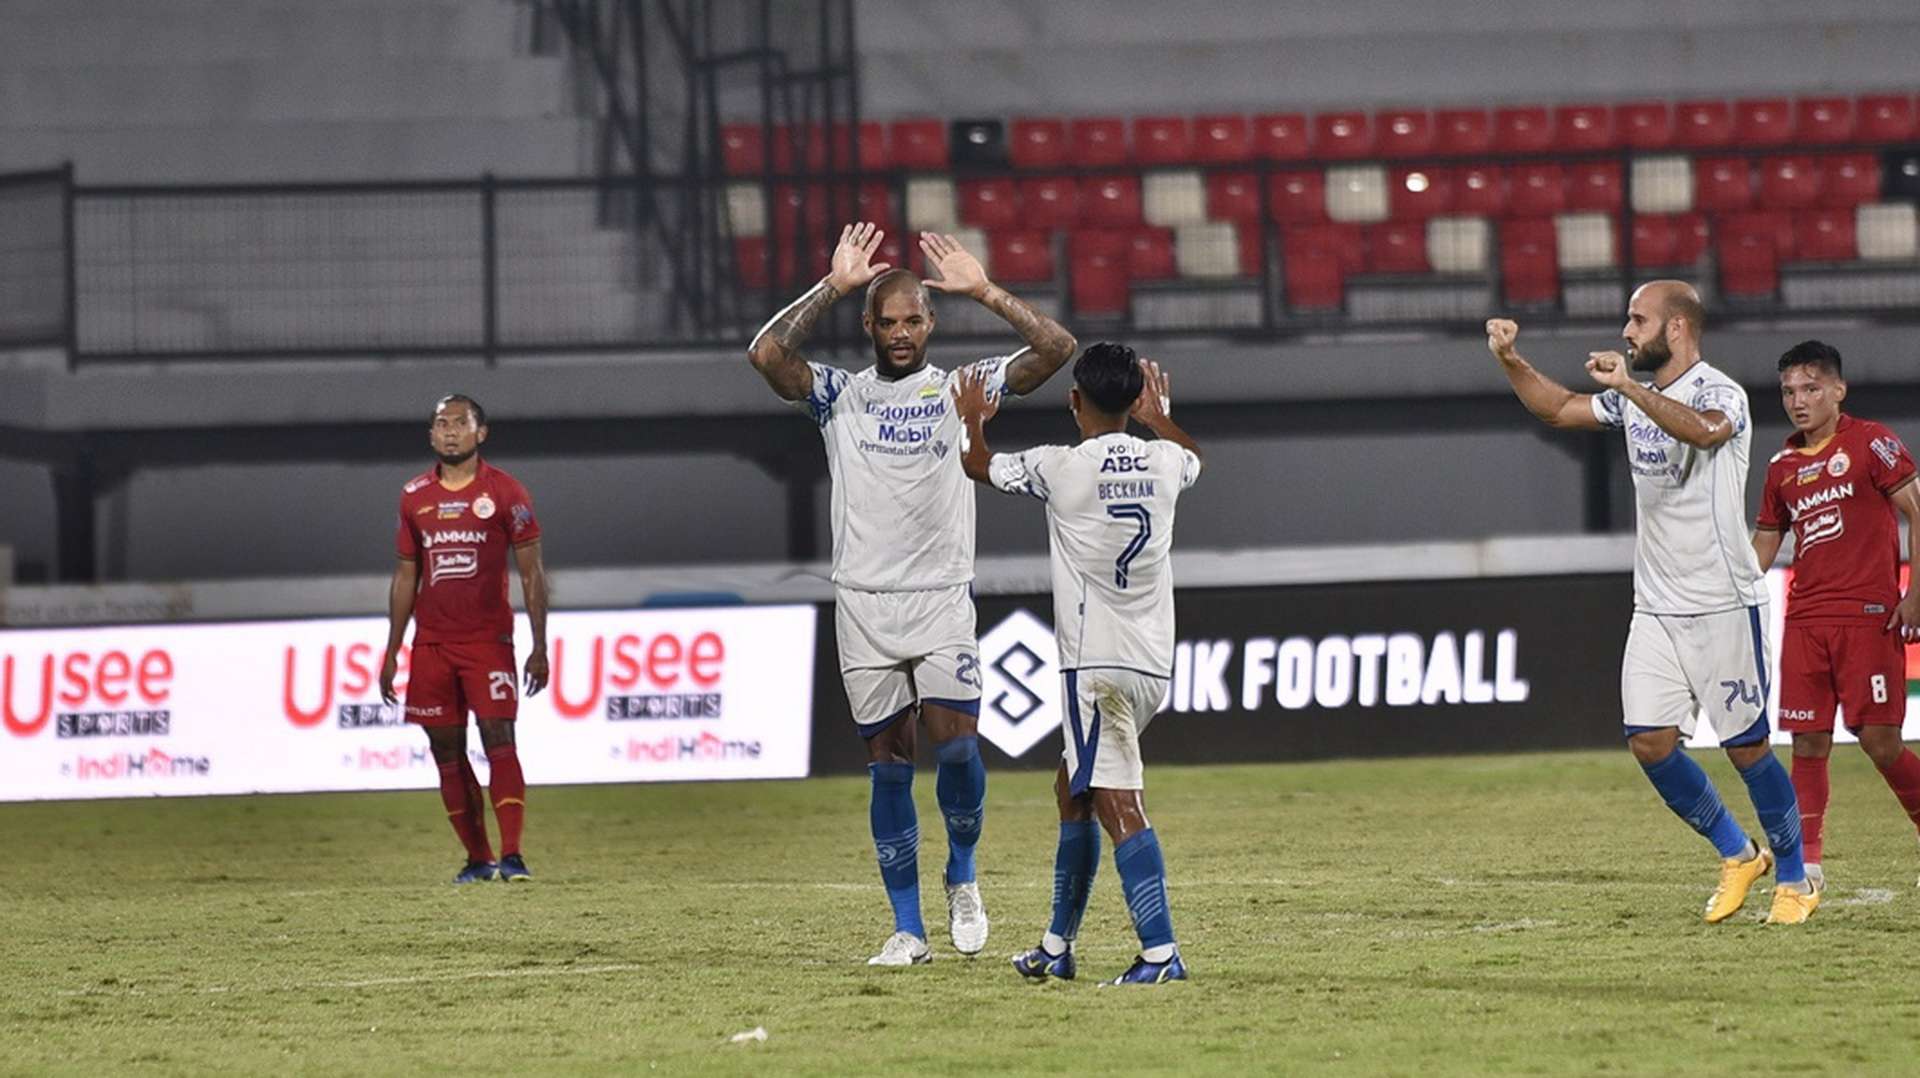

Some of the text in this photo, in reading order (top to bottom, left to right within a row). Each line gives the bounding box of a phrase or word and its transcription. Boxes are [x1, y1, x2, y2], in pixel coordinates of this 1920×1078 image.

[879, 424, 932, 442] Mobil
[1100, 456, 1149, 473] ABC
[1098, 482, 1154, 499] BECKHAM
[1797, 483, 1853, 512] AMMAN
[433, 531, 487, 543] AMMAN
[1107, 504, 1151, 588] 7
[1240, 628, 1529, 710] FOOTBALL
[1720, 679, 1760, 712] 74
[1871, 674, 1888, 704] 8
[607, 694, 721, 720] SPORTS
[57, 711, 170, 738] SPORTS
[627, 731, 761, 761] IndiHome
[78, 747, 209, 779] IndiHome
